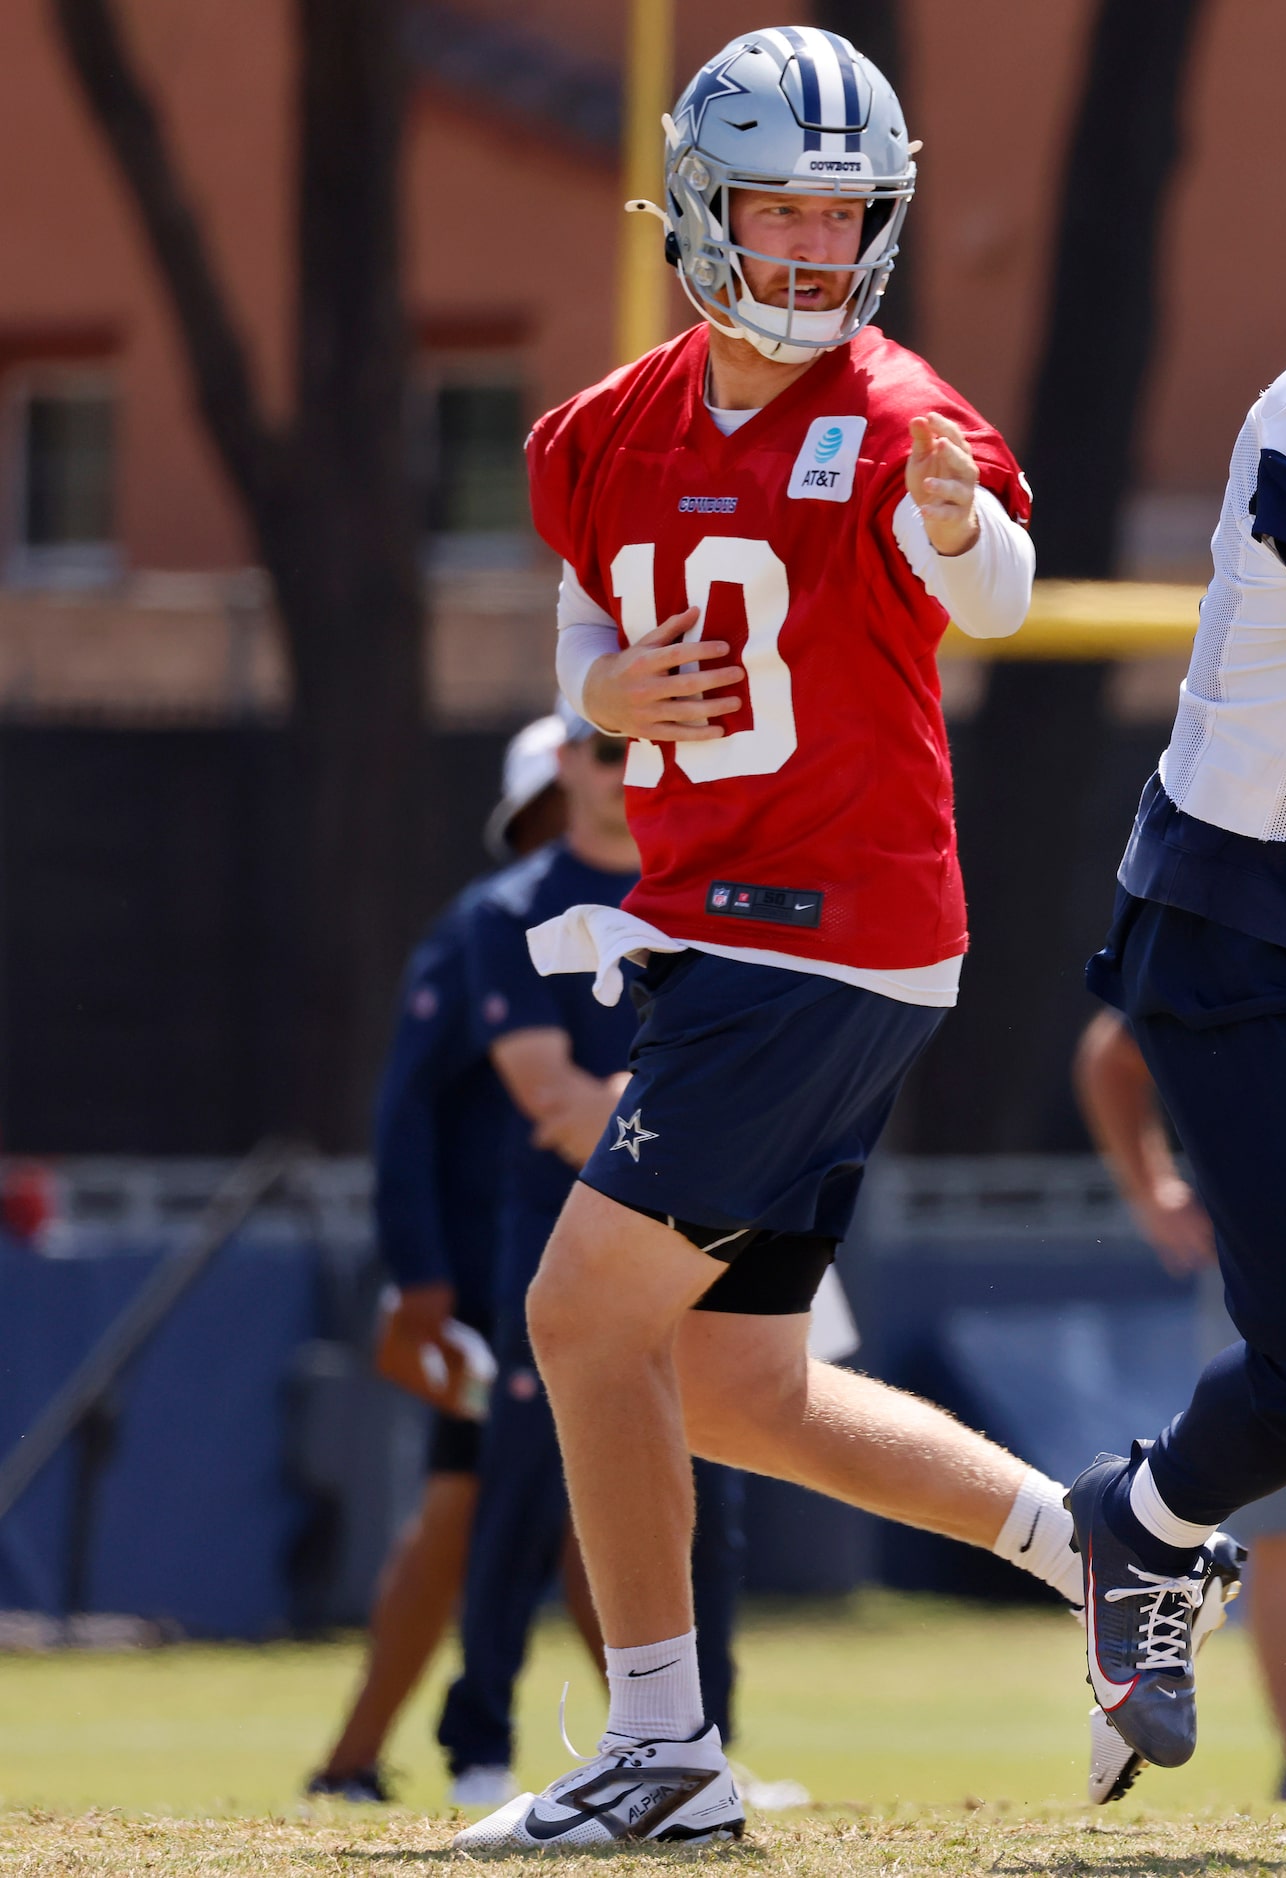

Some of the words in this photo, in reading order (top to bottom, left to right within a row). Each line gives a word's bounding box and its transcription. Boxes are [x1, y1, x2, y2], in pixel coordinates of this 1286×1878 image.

[810, 161, 862, 172] COWBOYS
[801, 470, 841, 488] AT&T
[610, 536, 798, 789] 10
[628, 1785, 675, 1824] ALPHA
